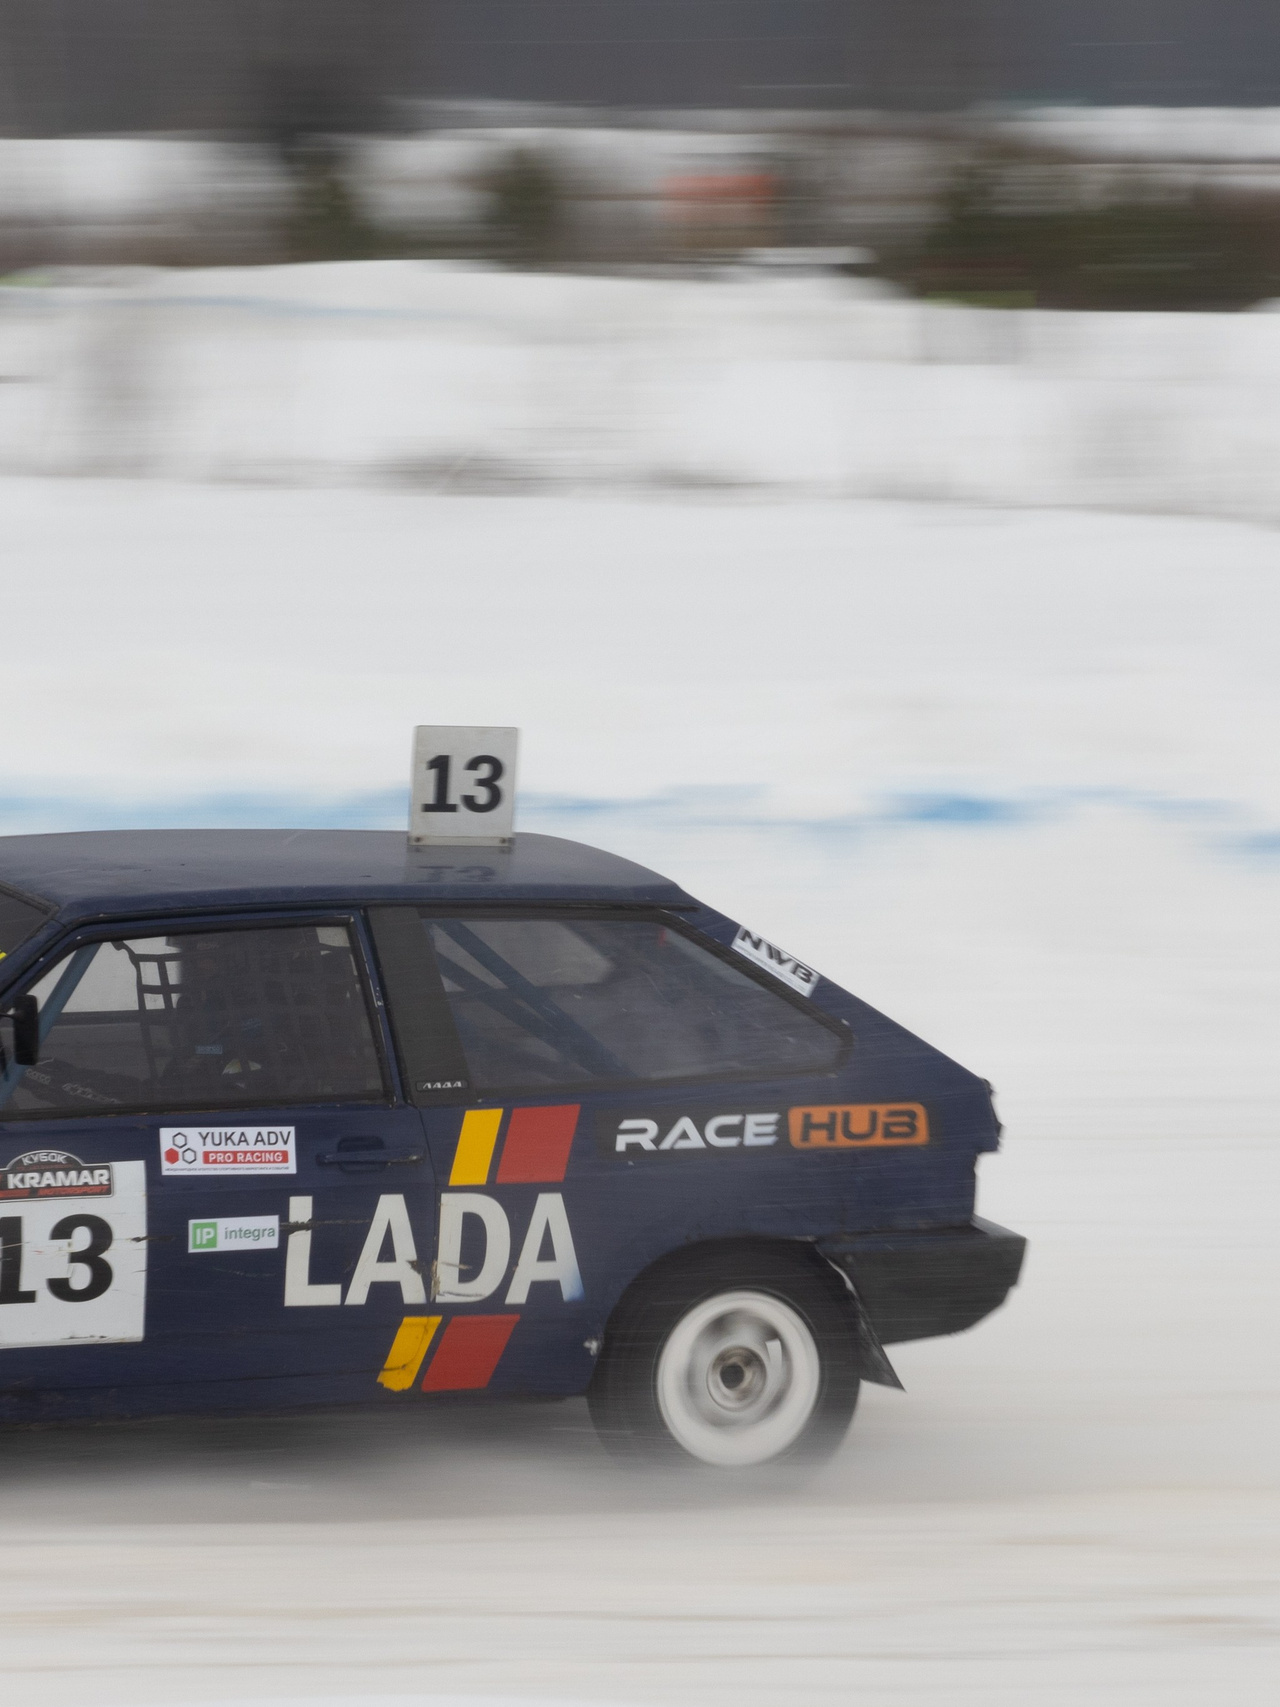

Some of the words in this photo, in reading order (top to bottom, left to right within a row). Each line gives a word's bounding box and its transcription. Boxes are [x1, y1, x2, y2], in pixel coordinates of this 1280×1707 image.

[421, 755, 505, 813] 13
[739, 929, 813, 984] NWB
[198, 1131, 249, 1146] YUKA
[254, 1130, 291, 1146] ADV
[615, 1112, 781, 1152] RACE
[800, 1109, 918, 1143] HUB
[21, 1152, 68, 1166] КУБОК
[208, 1152, 233, 1163] PRO
[237, 1152, 283, 1163] RACING
[7, 1169, 110, 1189] KRAMAR
[195, 1228, 215, 1245] IP
[224, 1227, 276, 1242] integra
[284, 1192, 587, 1307] LADA
